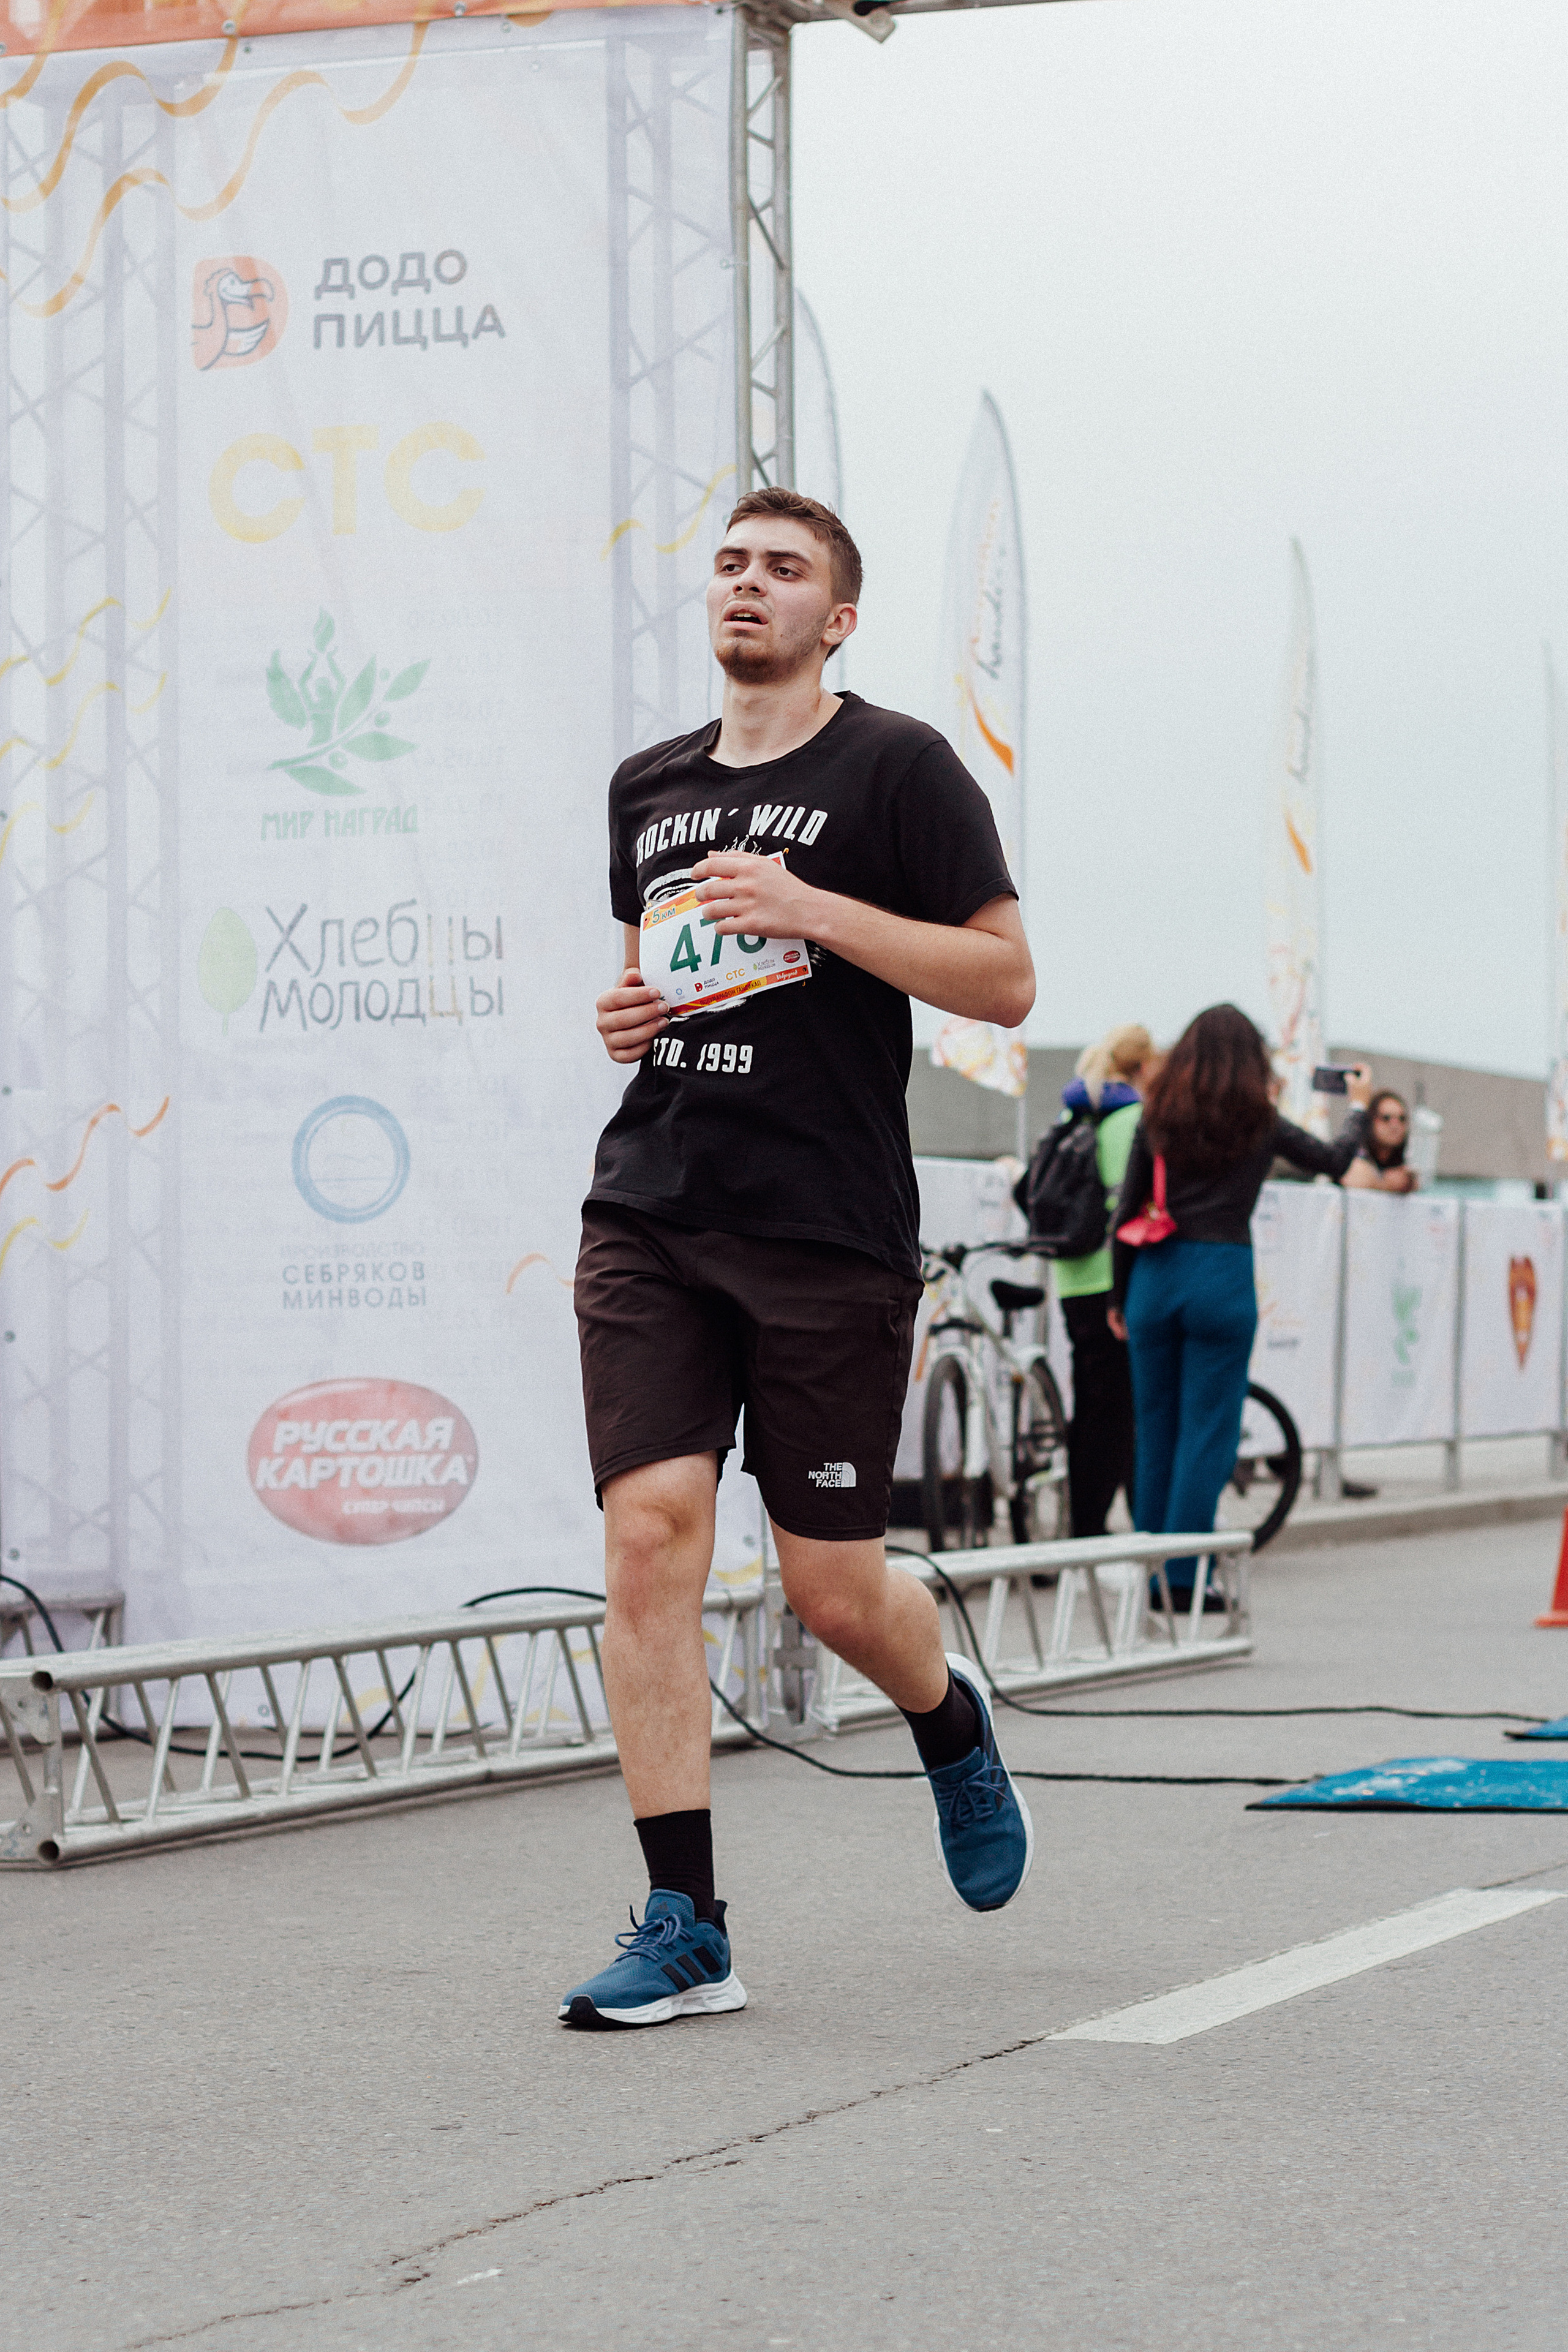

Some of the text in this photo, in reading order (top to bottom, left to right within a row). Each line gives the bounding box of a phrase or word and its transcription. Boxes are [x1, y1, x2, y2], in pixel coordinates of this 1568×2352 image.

[314, 249, 467, 301] ДОДО
[313, 303, 507, 351] ПИЦЦА
[208, 421, 486, 543] СТС
[260, 804, 419, 841] МИР НАГРАД
[748, 804, 828, 846] WILD
[726, 968, 745, 981] СТС
[696, 1043, 753, 1073] 1999
[282, 1261, 425, 1284] СЕБРЯКОВ
[282, 1287, 426, 1310] МИНВОДЫ
[273, 1417, 457, 1455] РУССКАЯ
[254, 1453, 469, 1490] КАРТОШКА
[808, 1471, 842, 1479] NORTH
[816, 1479, 842, 1488] FACE
[823, 1463, 843, 1471] THE
